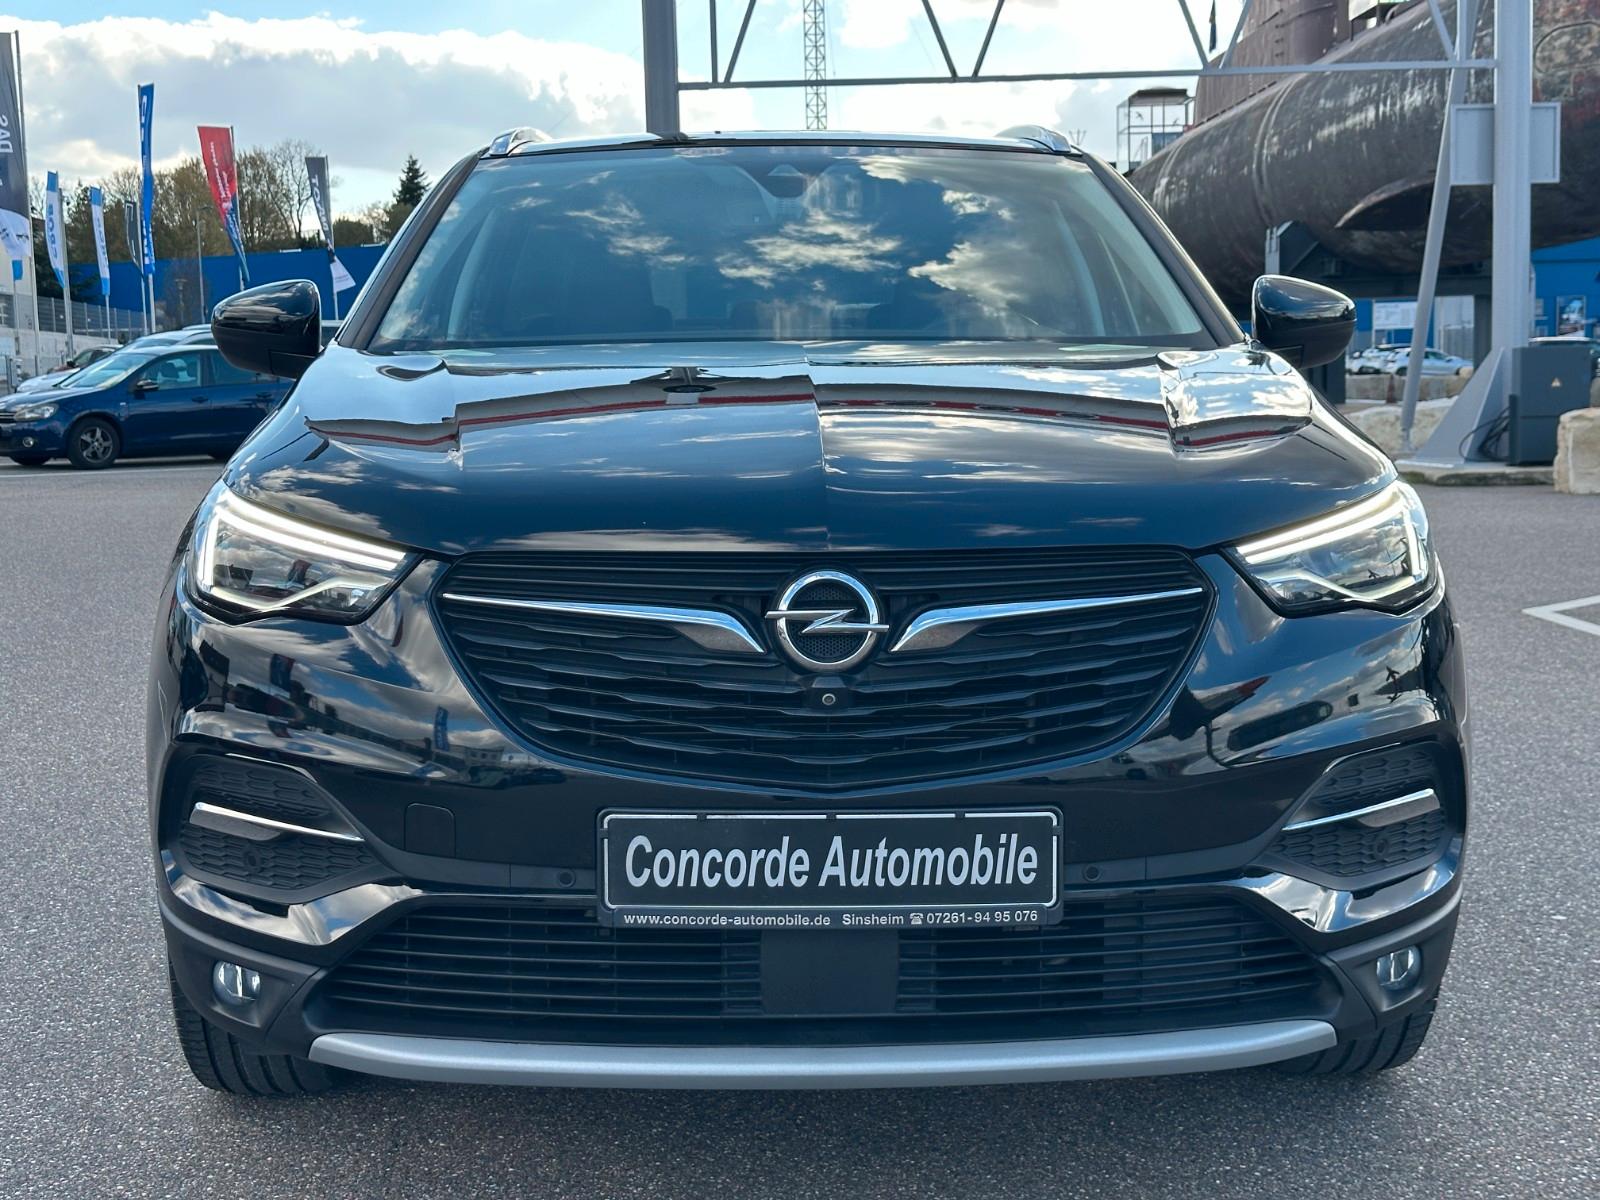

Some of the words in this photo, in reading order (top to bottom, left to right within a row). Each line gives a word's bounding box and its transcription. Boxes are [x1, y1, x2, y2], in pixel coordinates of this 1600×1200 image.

[626, 835, 809, 887] Concorde
[818, 834, 1037, 887] Automobile
[624, 914, 830, 925] www.concorde-automobile.de
[842, 914, 903, 925] Sinsheim
[995, 911, 1010, 922] 95
[1015, 911, 1037, 921] 076
